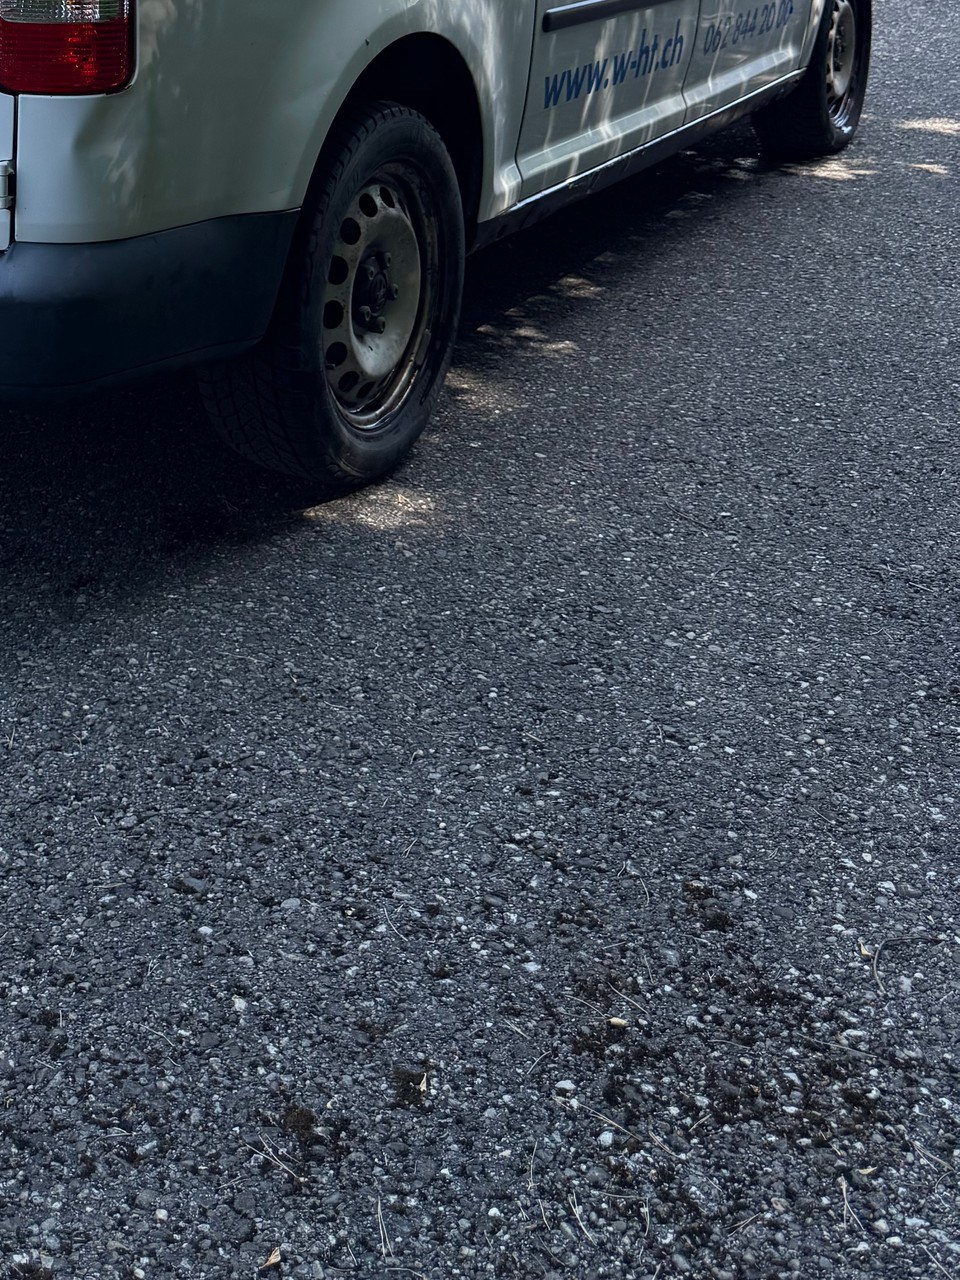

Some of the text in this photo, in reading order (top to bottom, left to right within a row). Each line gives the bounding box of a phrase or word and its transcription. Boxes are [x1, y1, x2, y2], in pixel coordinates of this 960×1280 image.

[544, 19, 684, 109] www.w-ht.ch
[703, 16, 731, 56] 062
[732, 8, 758, 45] 844
[758, 1, 776, 35] 20
